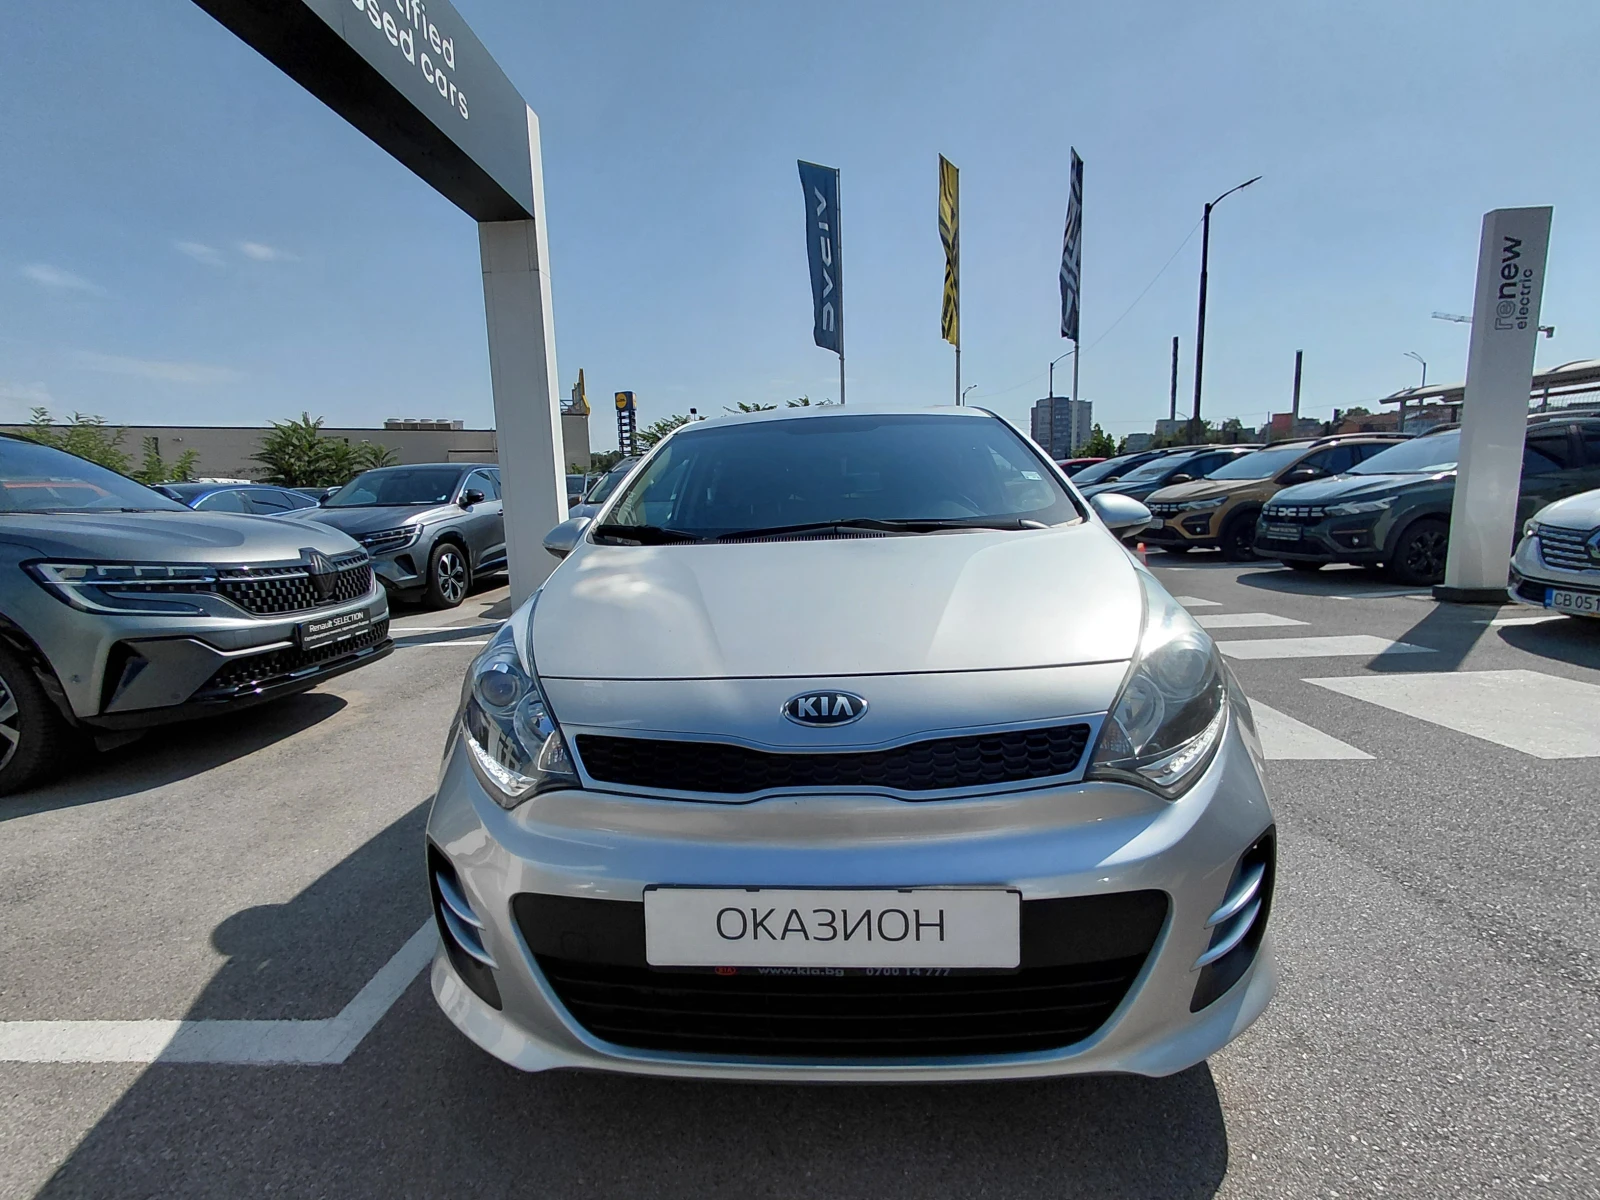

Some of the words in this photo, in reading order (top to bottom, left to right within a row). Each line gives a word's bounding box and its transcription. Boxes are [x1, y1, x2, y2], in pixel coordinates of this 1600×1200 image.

[421, 52, 469, 119] cars
[1495, 236, 1522, 330] renew
[1516, 268, 1533, 330] electric
[1554, 593, 1572, 607] CB
[309, 620, 334, 632] Renault
[333, 611, 364, 626] SELECTION
[797, 696, 854, 717] KIA
[716, 907, 945, 942] ОКАЗИОН
[758, 967, 845, 977] www.kia.bg
[866, 967, 900, 976] 0700
[906, 968, 920, 976] 14
[926, 968, 950, 977] 777
